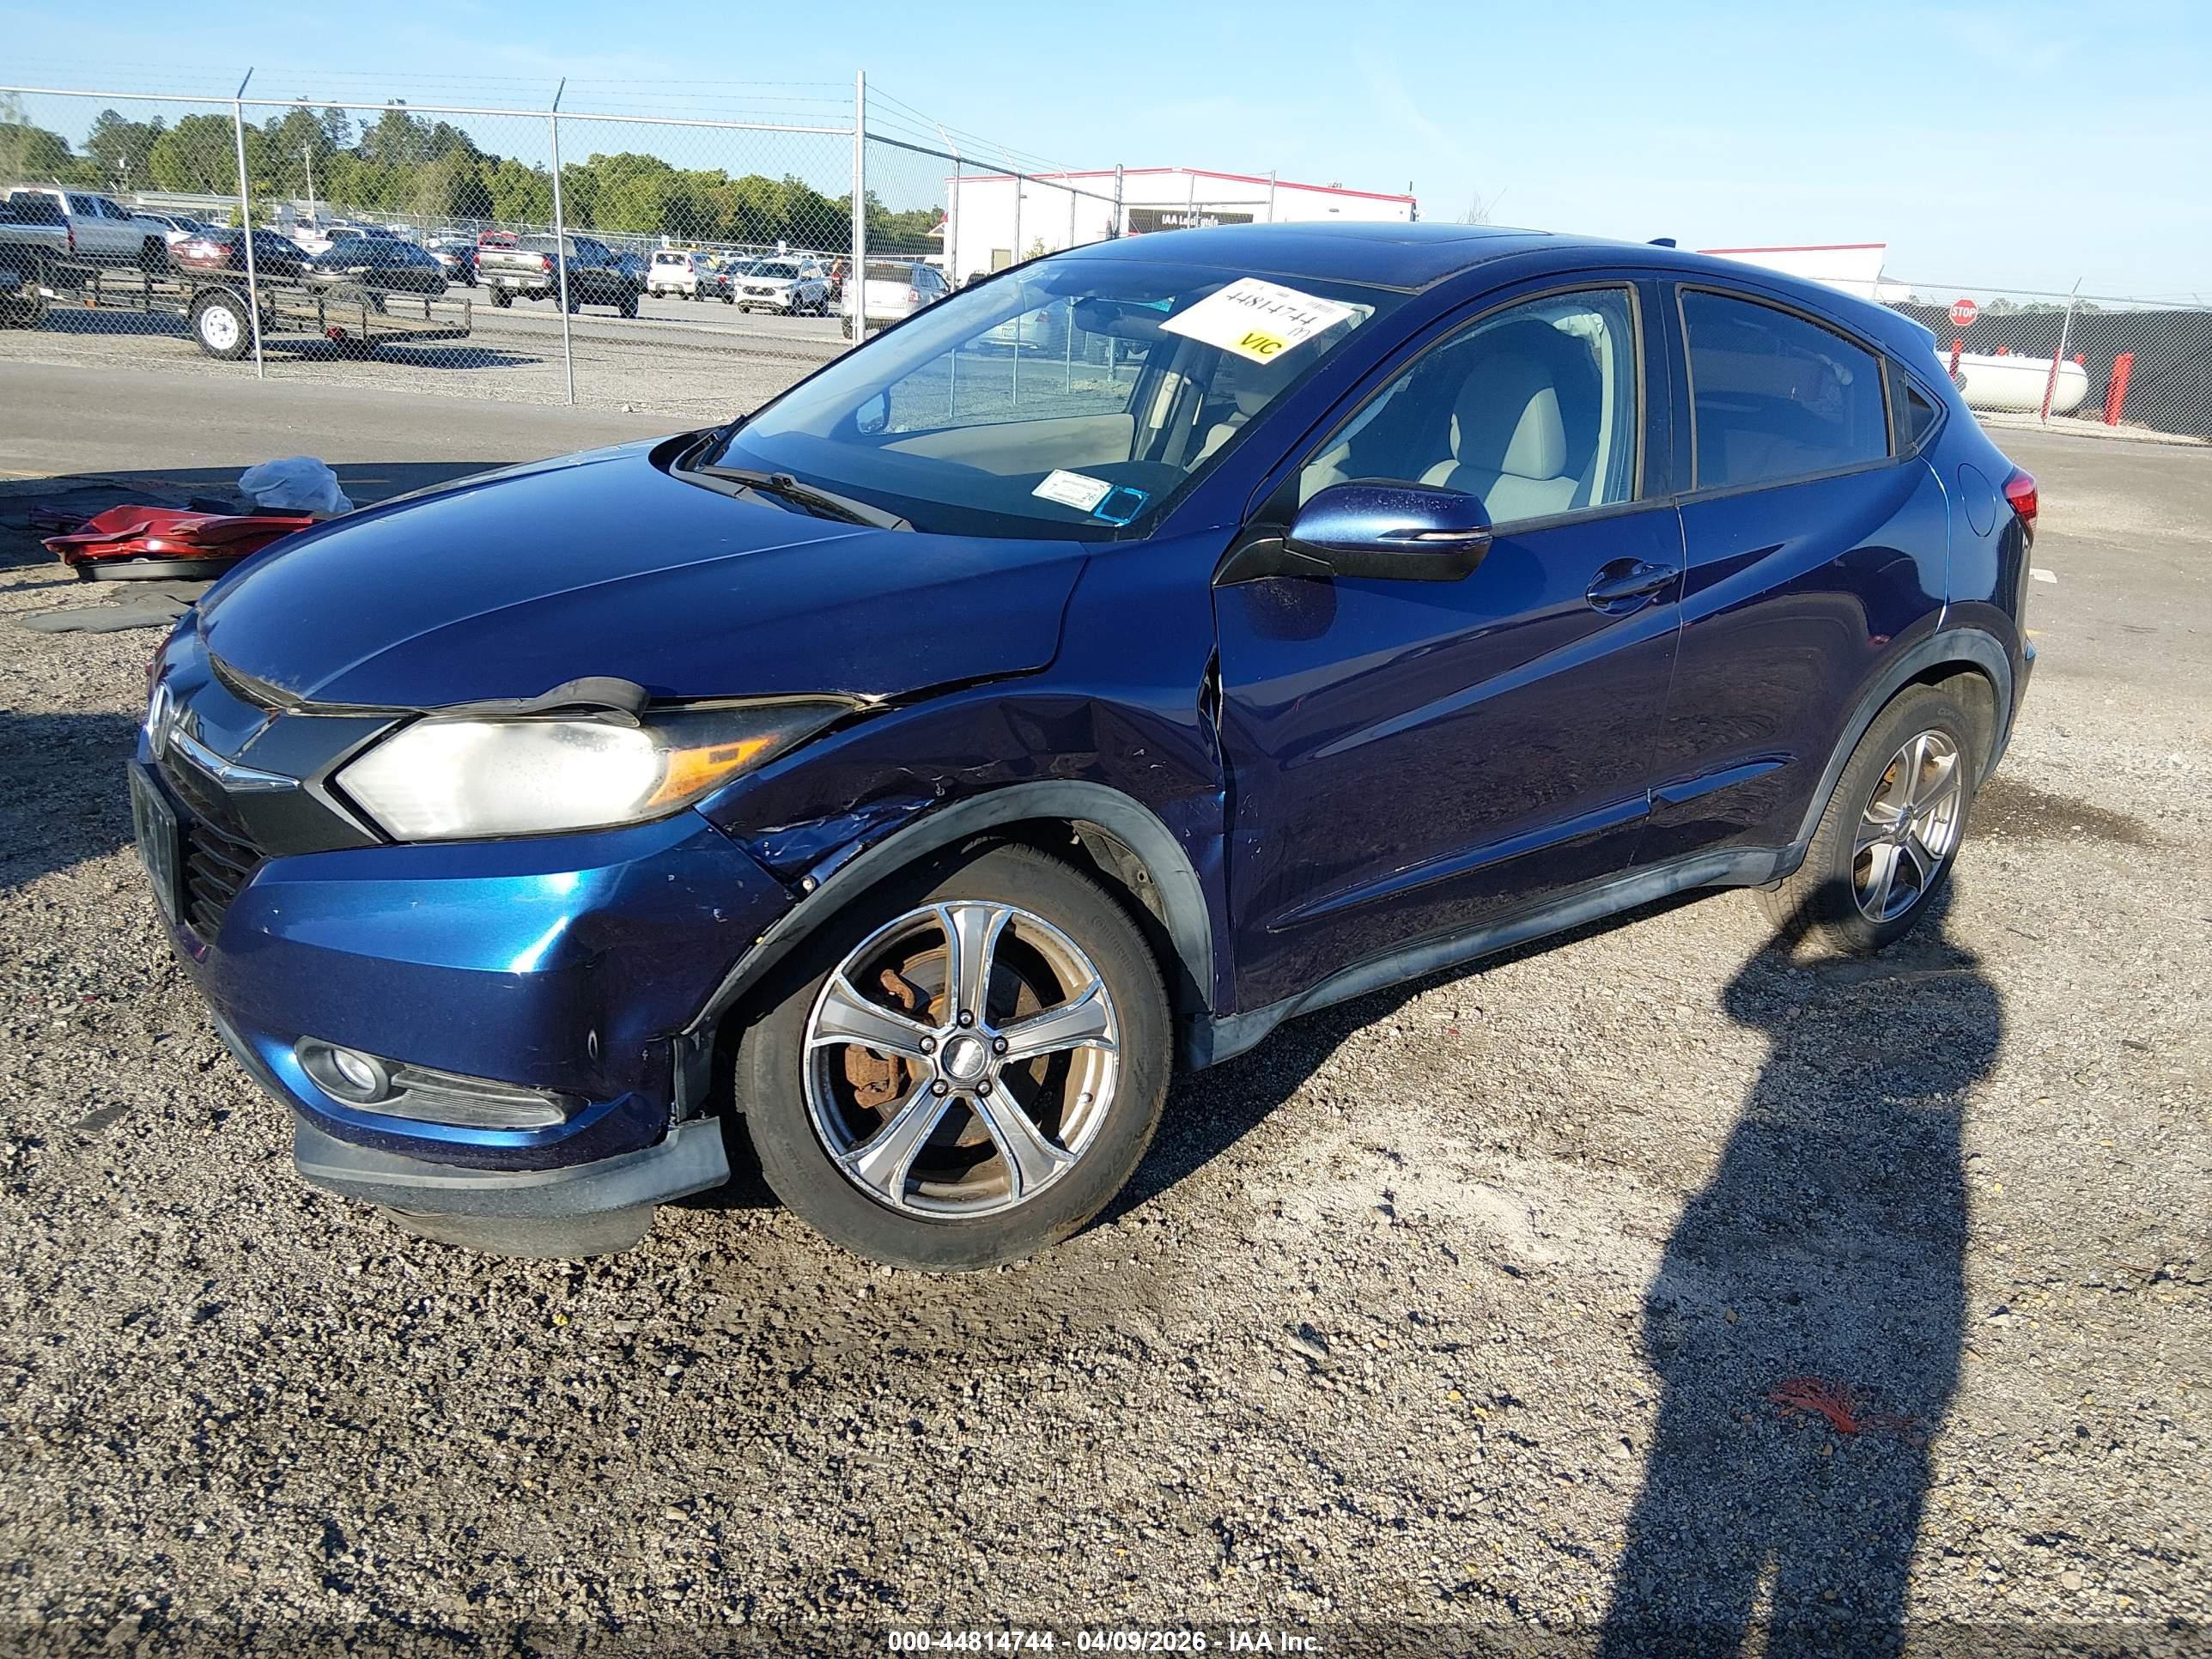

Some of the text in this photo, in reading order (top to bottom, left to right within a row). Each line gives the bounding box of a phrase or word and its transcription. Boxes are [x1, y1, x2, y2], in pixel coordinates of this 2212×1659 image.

[1162, 214, 1178, 225] IAA
[1226, 291, 1318, 325] 44814744
[1951, 306, 1977, 318] STOP
[1240, 332, 1282, 355] VIC
